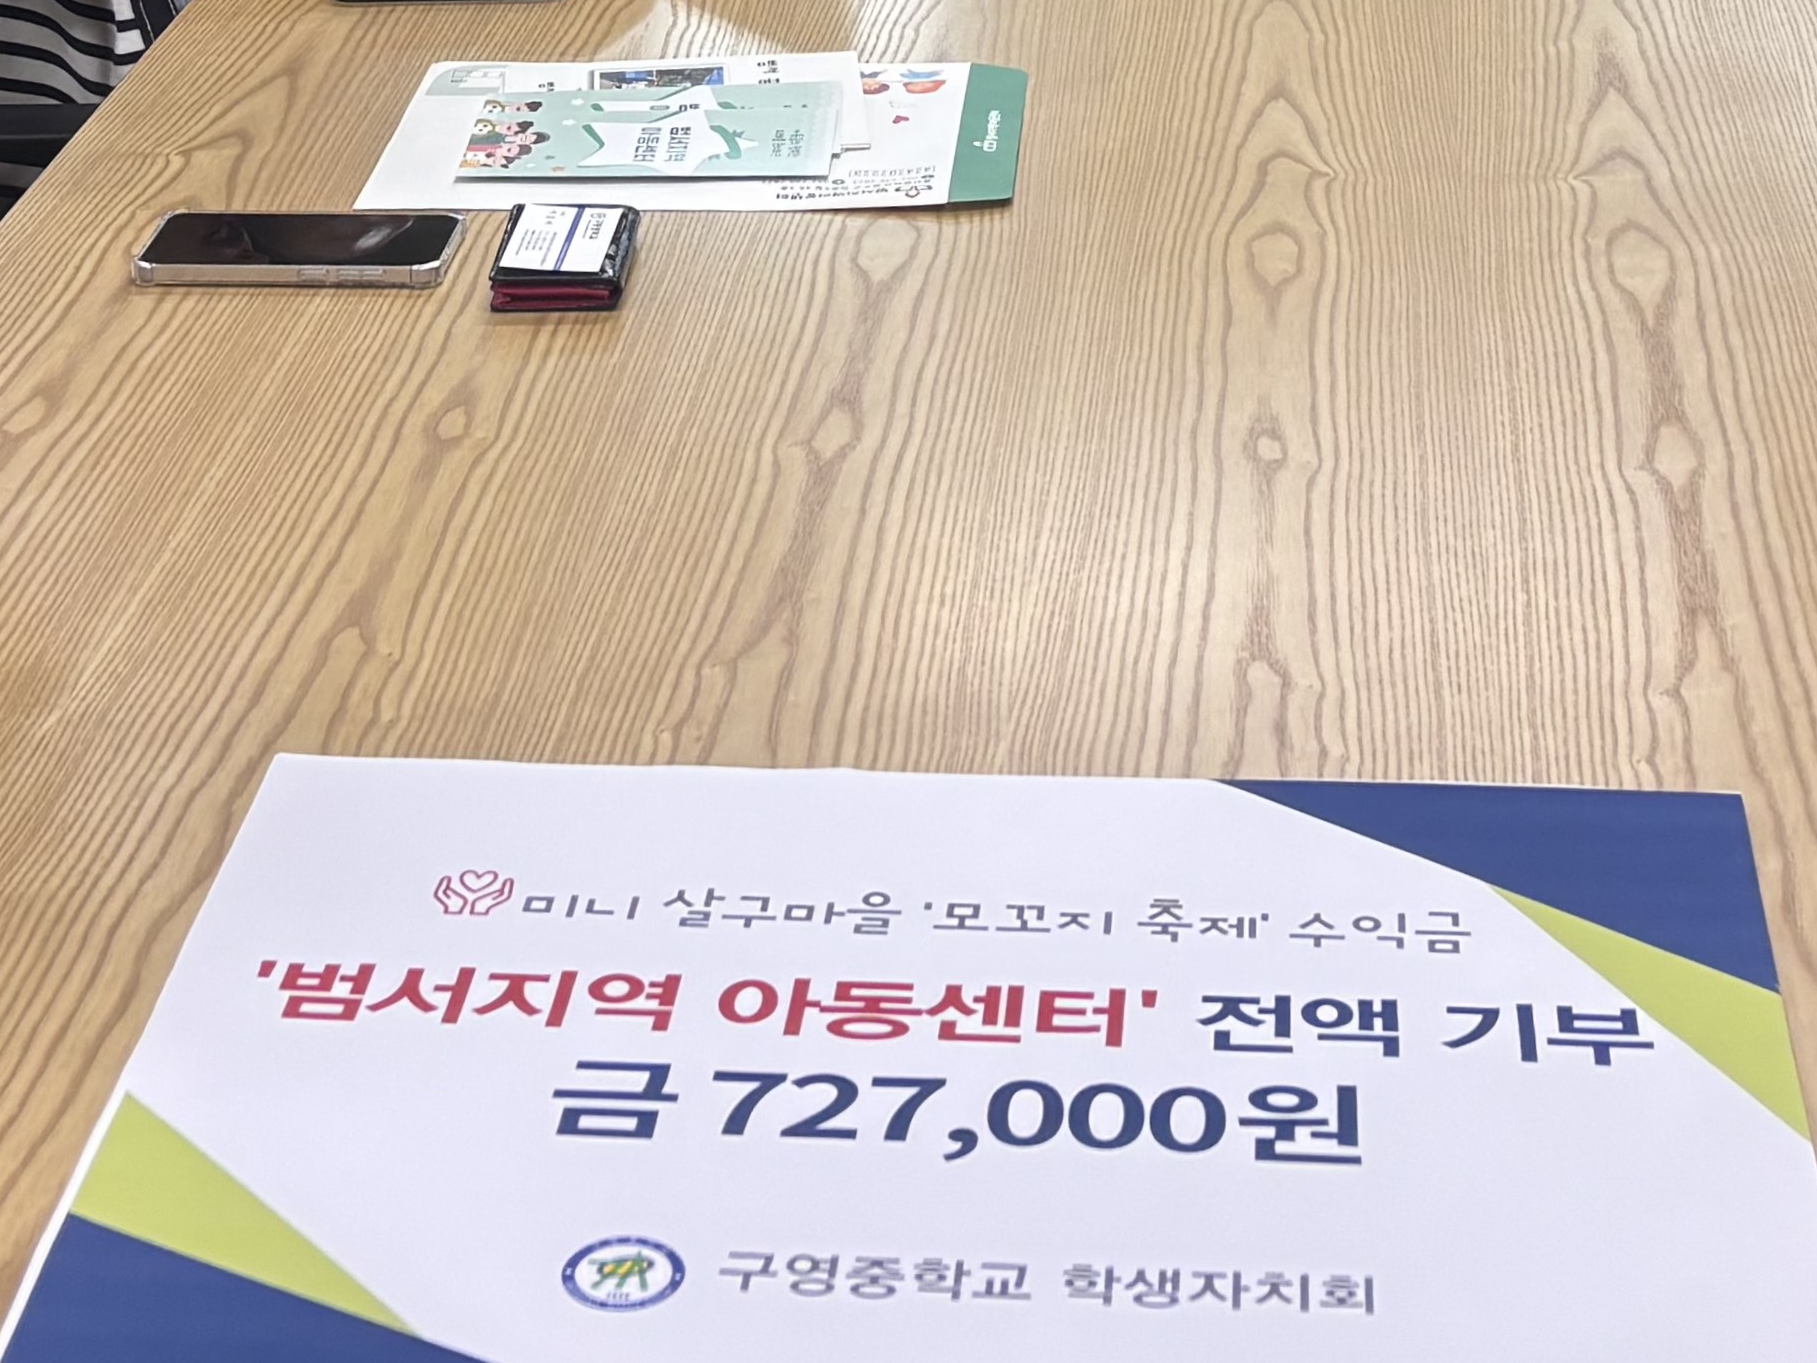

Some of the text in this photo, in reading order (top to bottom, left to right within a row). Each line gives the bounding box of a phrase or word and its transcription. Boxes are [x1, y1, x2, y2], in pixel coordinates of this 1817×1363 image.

[521, 887, 1472, 954] 미니 살구마을 '모꼬지 축제' 수익금
[256, 959, 1655, 1067] '범서지역 아동센터' 전액 기부
[552, 1059, 1363, 1166] 금 727,000원
[718, 1250, 1032, 1301] 구영중학교
[1063, 1263, 1375, 1314] 학생자치회
